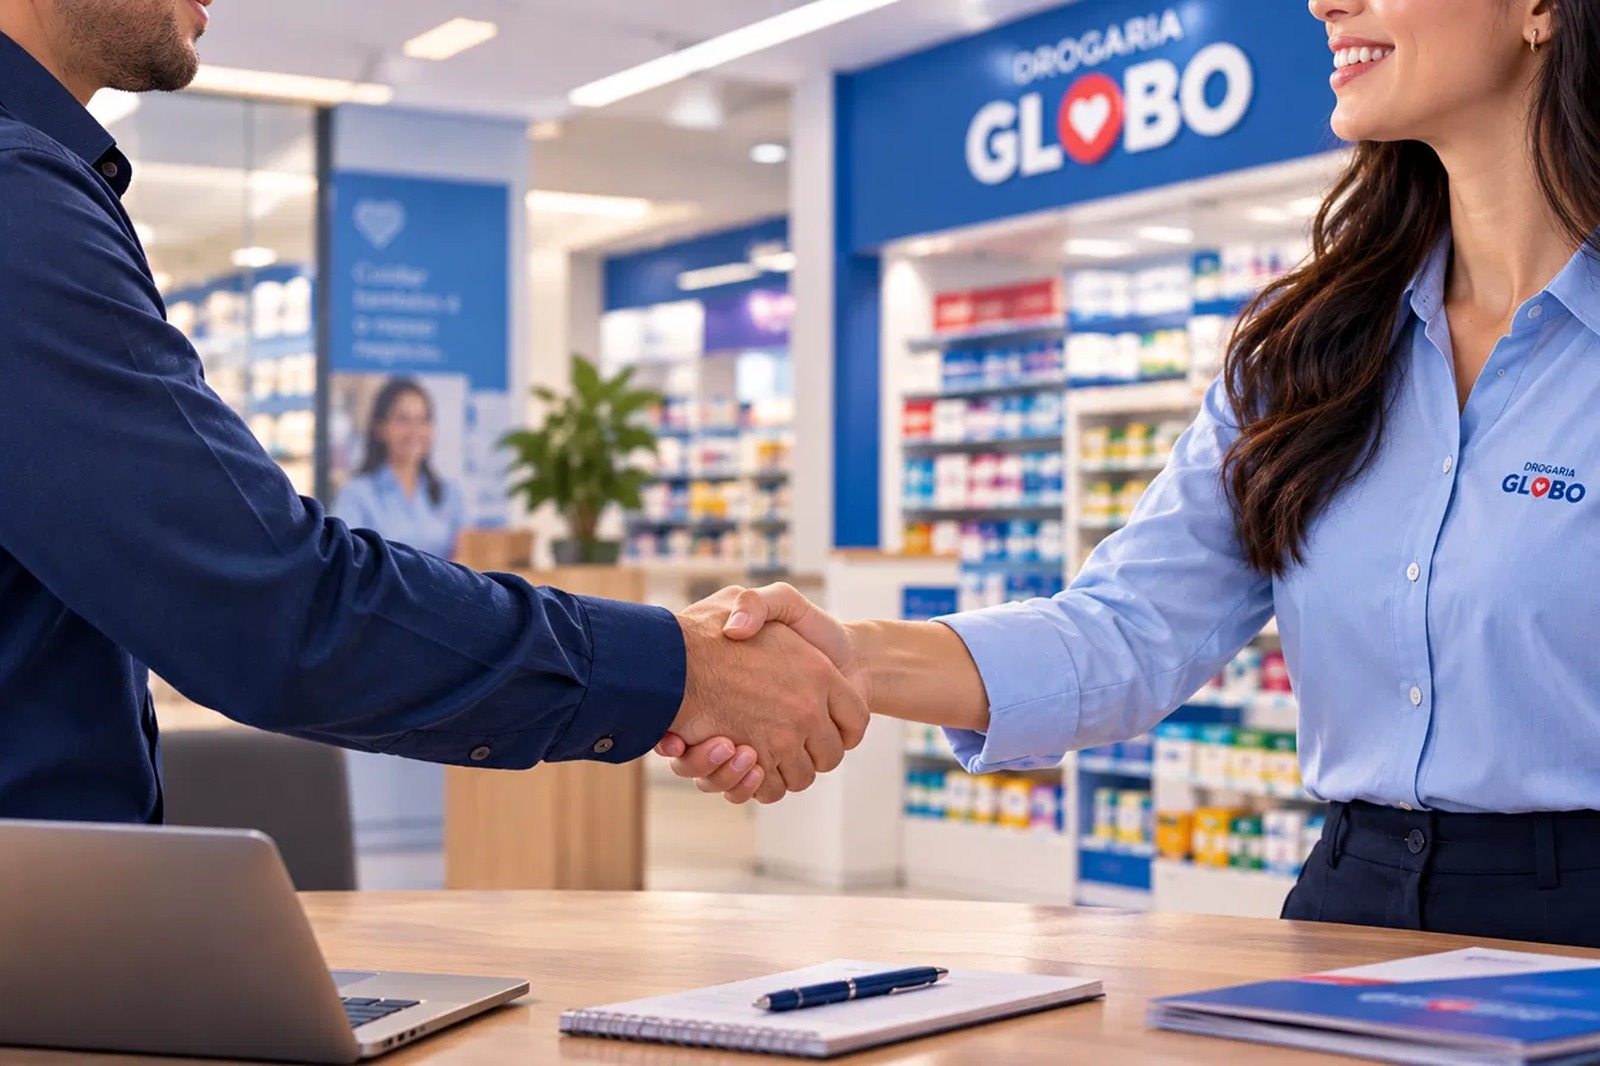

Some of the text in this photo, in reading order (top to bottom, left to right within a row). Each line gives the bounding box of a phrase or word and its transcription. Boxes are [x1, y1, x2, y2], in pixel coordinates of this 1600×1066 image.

[1012, 8, 1184, 85] DROGARIA
[965, 41, 1254, 185] GLOBO
[1502, 473, 1586, 503] GLOBO
[1524, 461, 1576, 478] DROGARIA
